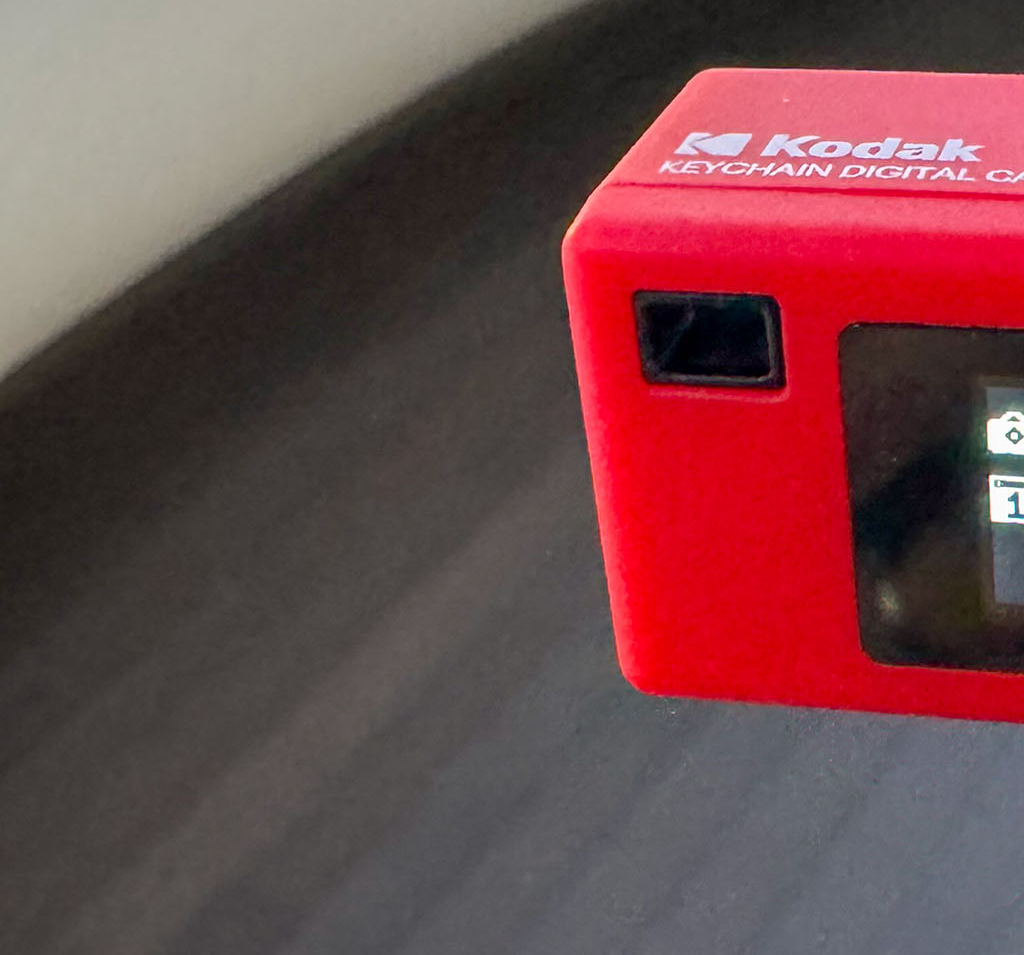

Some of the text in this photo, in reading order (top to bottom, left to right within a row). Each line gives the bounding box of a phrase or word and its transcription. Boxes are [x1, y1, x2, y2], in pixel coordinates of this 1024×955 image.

[760, 133, 984, 162] Kodak
[658, 160, 832, 178] KEYCHAIN
[839, 164, 976, 183] DIGITAL
